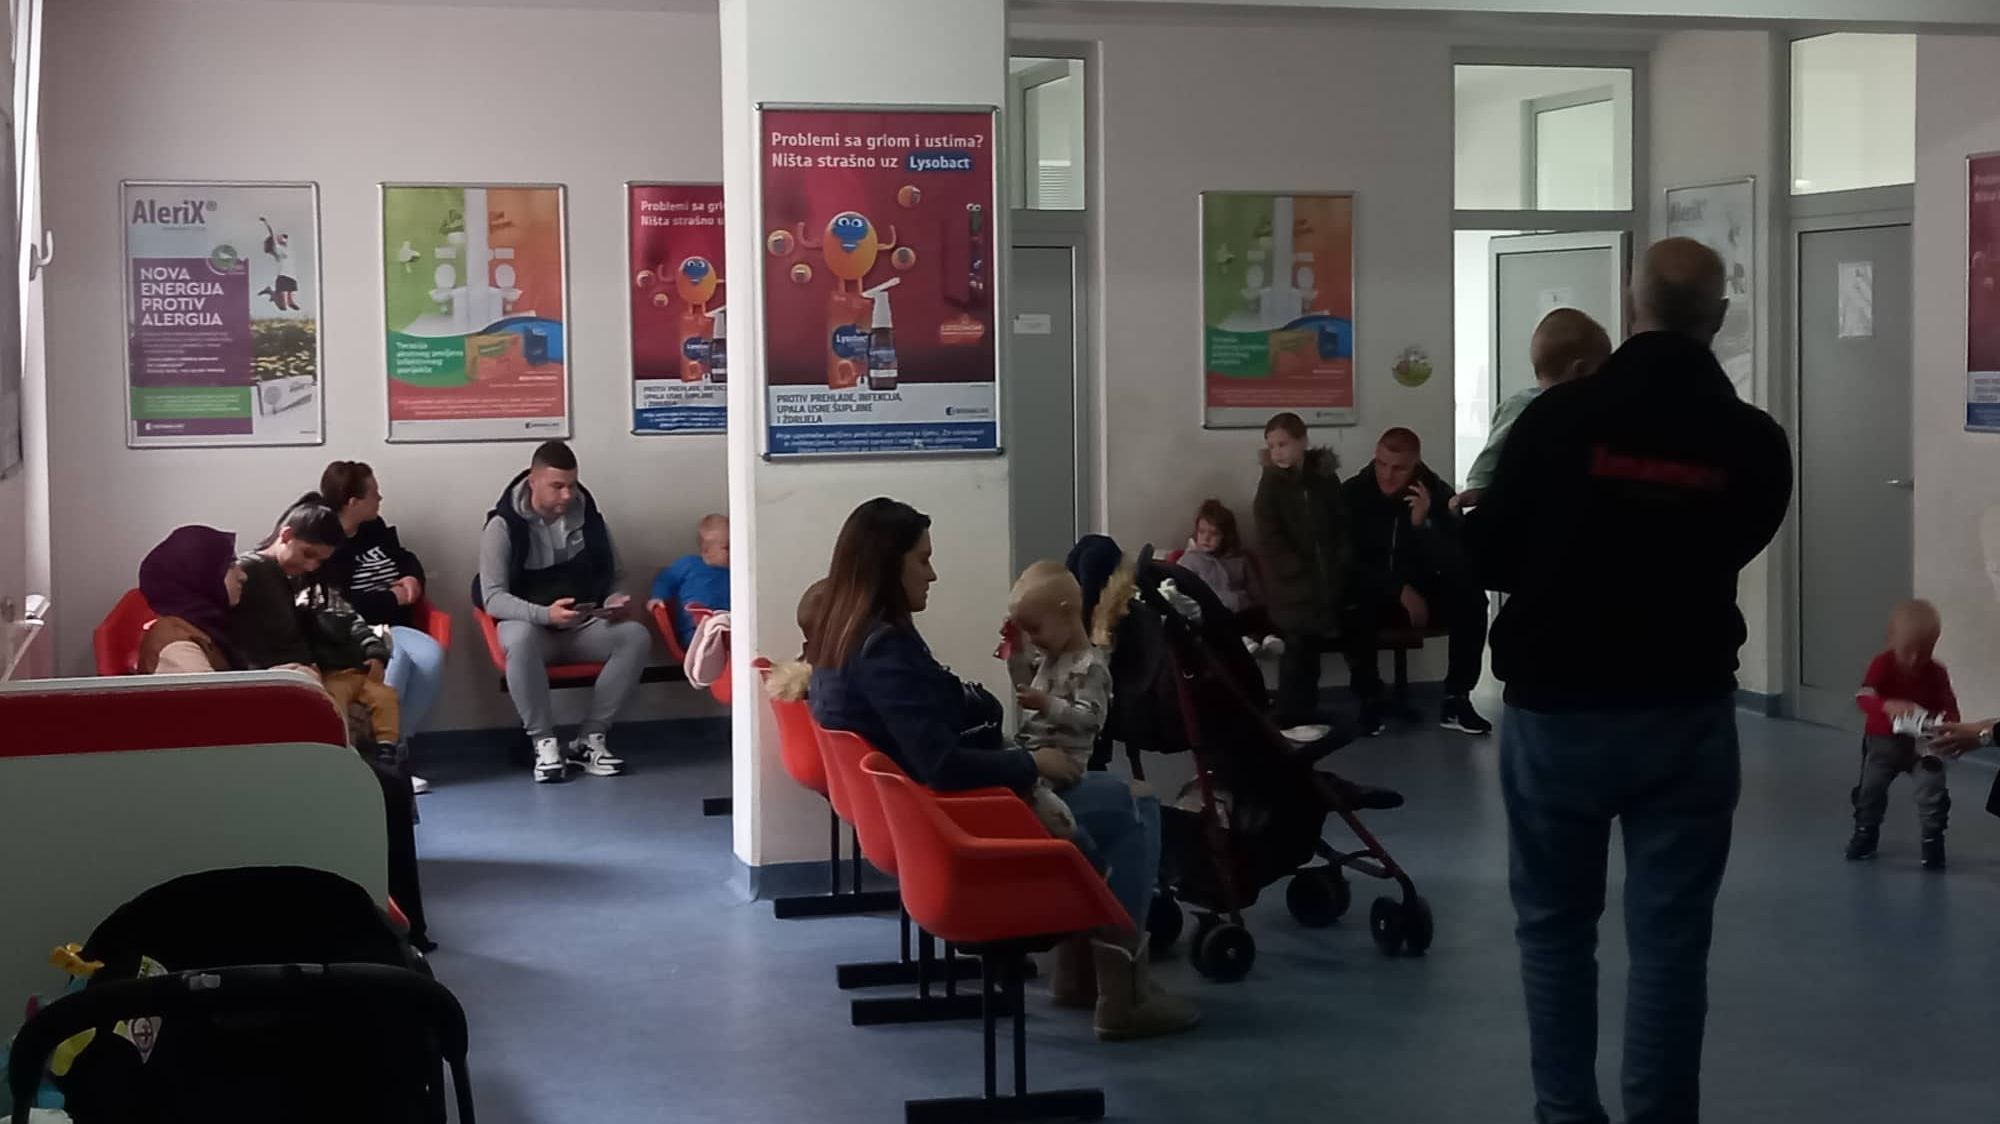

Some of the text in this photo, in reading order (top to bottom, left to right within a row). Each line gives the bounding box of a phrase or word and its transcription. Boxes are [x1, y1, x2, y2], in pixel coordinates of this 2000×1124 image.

[771, 131, 984, 150] Problemi sa grlom i ustima?
[772, 152, 970, 172] Ništa strašno uz Lysobact
[640, 200, 689, 211] Problemi
[691, 202, 705, 211] sa
[640, 215, 670, 226] Ništa
[672, 215, 714, 226] strašno
[140, 266, 191, 281] NOVA
[141, 282, 225, 296] ENERGIJA
[141, 297, 207, 312] PROTIV
[141, 312, 224, 327] ALERGIJA
[776, 394, 808, 403] PROTIV
[776, 404, 806, 413] UPALA
